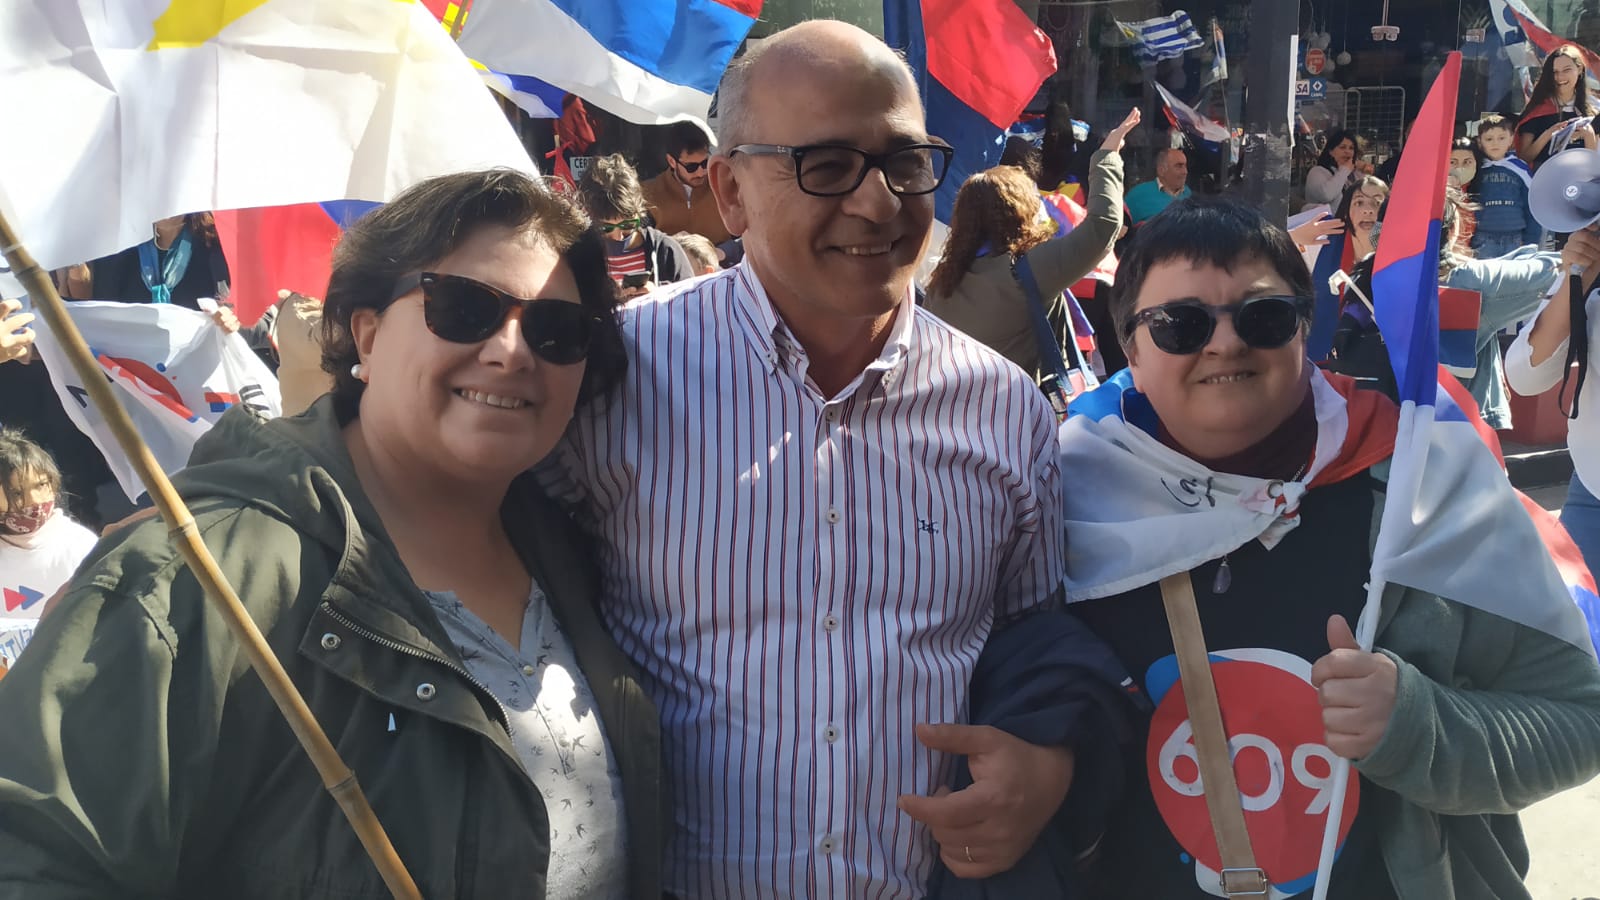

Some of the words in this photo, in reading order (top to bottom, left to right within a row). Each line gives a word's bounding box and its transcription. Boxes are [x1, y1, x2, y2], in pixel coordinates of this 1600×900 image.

[1296, 83, 1308, 93] SA
[574, 158, 592, 169] CER
[1159, 719, 1340, 815] 609
